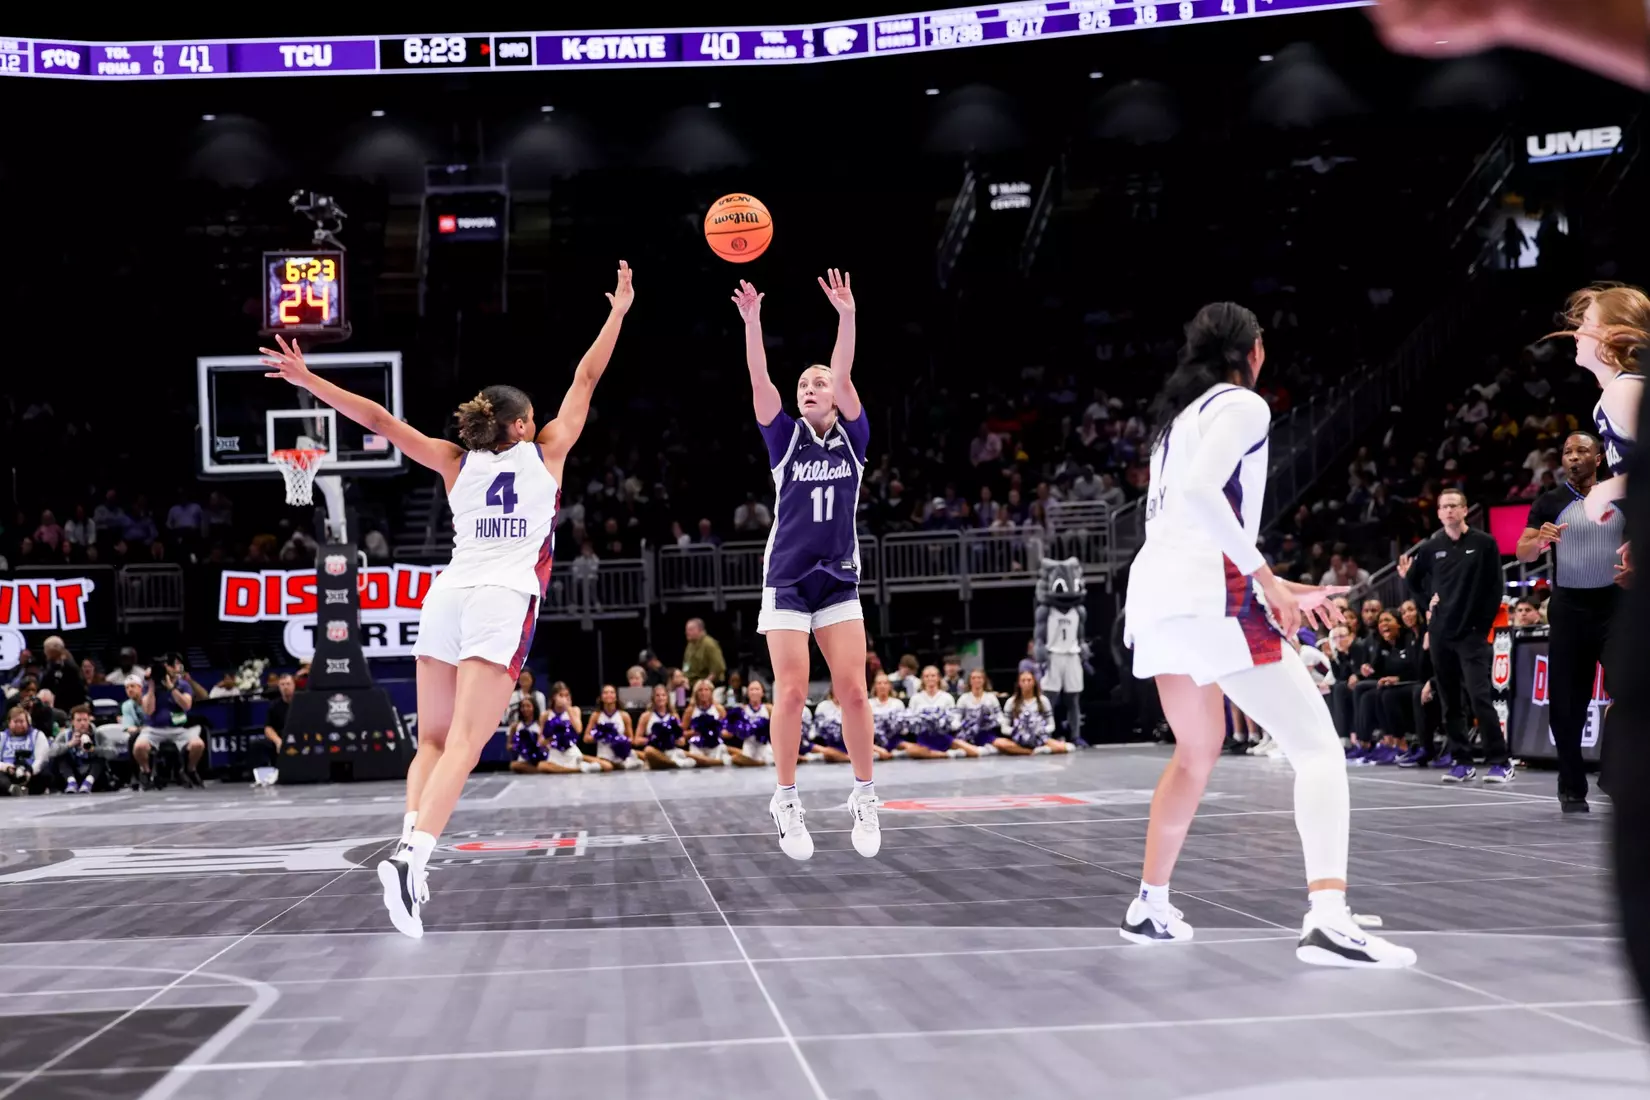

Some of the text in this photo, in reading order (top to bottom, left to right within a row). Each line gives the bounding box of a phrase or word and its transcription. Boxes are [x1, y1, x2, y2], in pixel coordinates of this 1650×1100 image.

[279, 44, 332, 68] TCU
[403, 37, 466, 64] 6:23
[562, 32, 740, 60] K-STATE 40
[178, 46, 213, 73] 41
[1526, 126, 1622, 157] UMB
[457, 217, 496, 229] TOYOTA
[714, 212, 759, 225] Wilson
[286, 259, 335, 282] 6:23
[279, 283, 329, 323] 24
[792, 459, 852, 481] Wildcats
[486, 472, 518, 514] 4
[810, 485, 835, 522] 11
[475, 518, 527, 538] HUNTER
[303, 622, 420, 648] TRE
